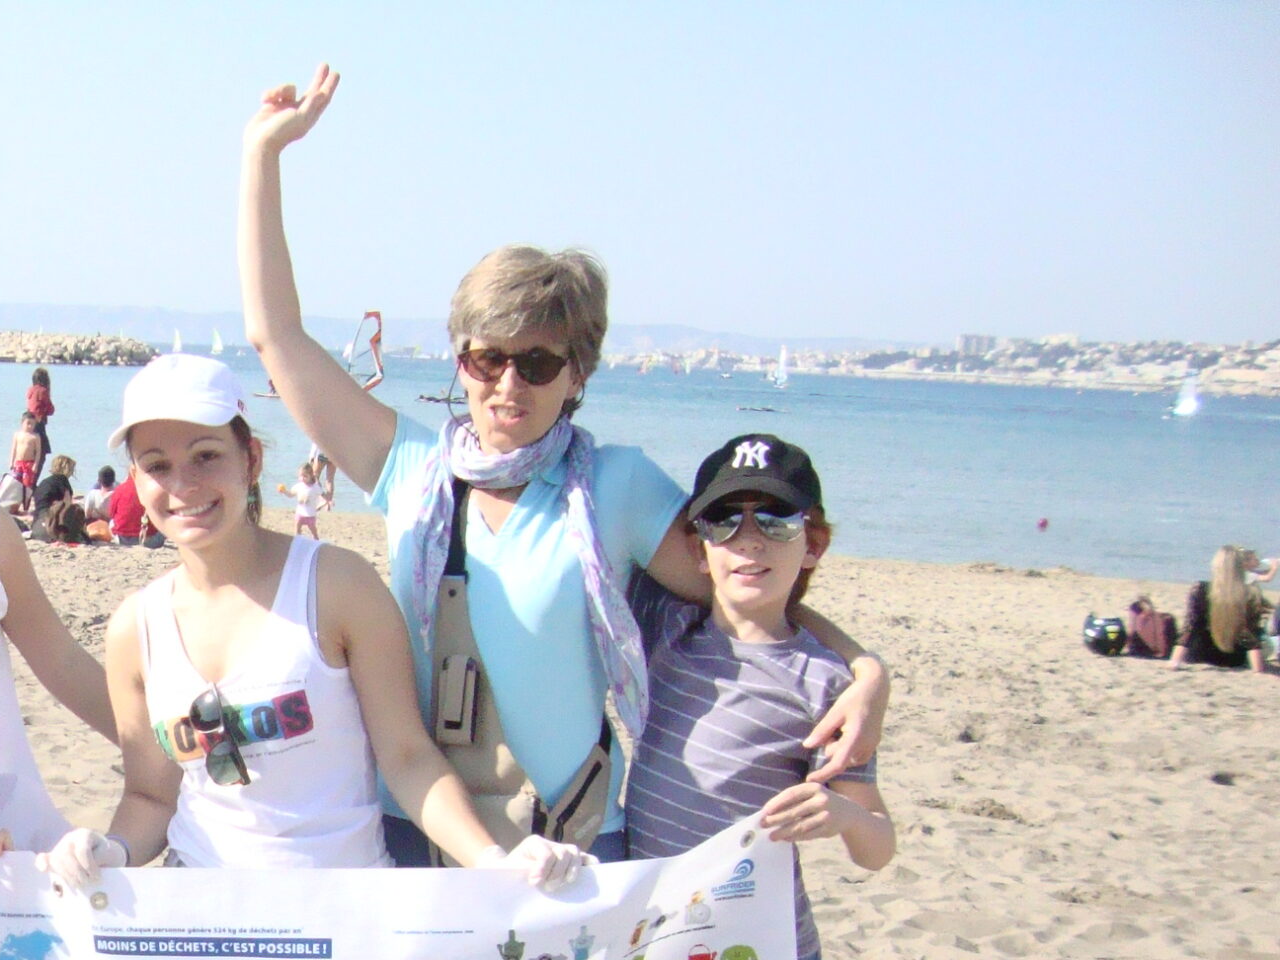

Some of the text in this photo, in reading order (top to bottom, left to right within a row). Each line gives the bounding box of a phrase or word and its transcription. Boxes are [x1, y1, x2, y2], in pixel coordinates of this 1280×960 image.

[126, 927, 291, 937] chaque personne génère kg de déchets par
[97, 940, 137, 952] MOINS
[139, 941, 156, 952] DE
[158, 939, 219, 954] DÉCHETS,
[221, 942, 255, 953] C'EST
[258, 942, 320, 955] POSSIBLE
